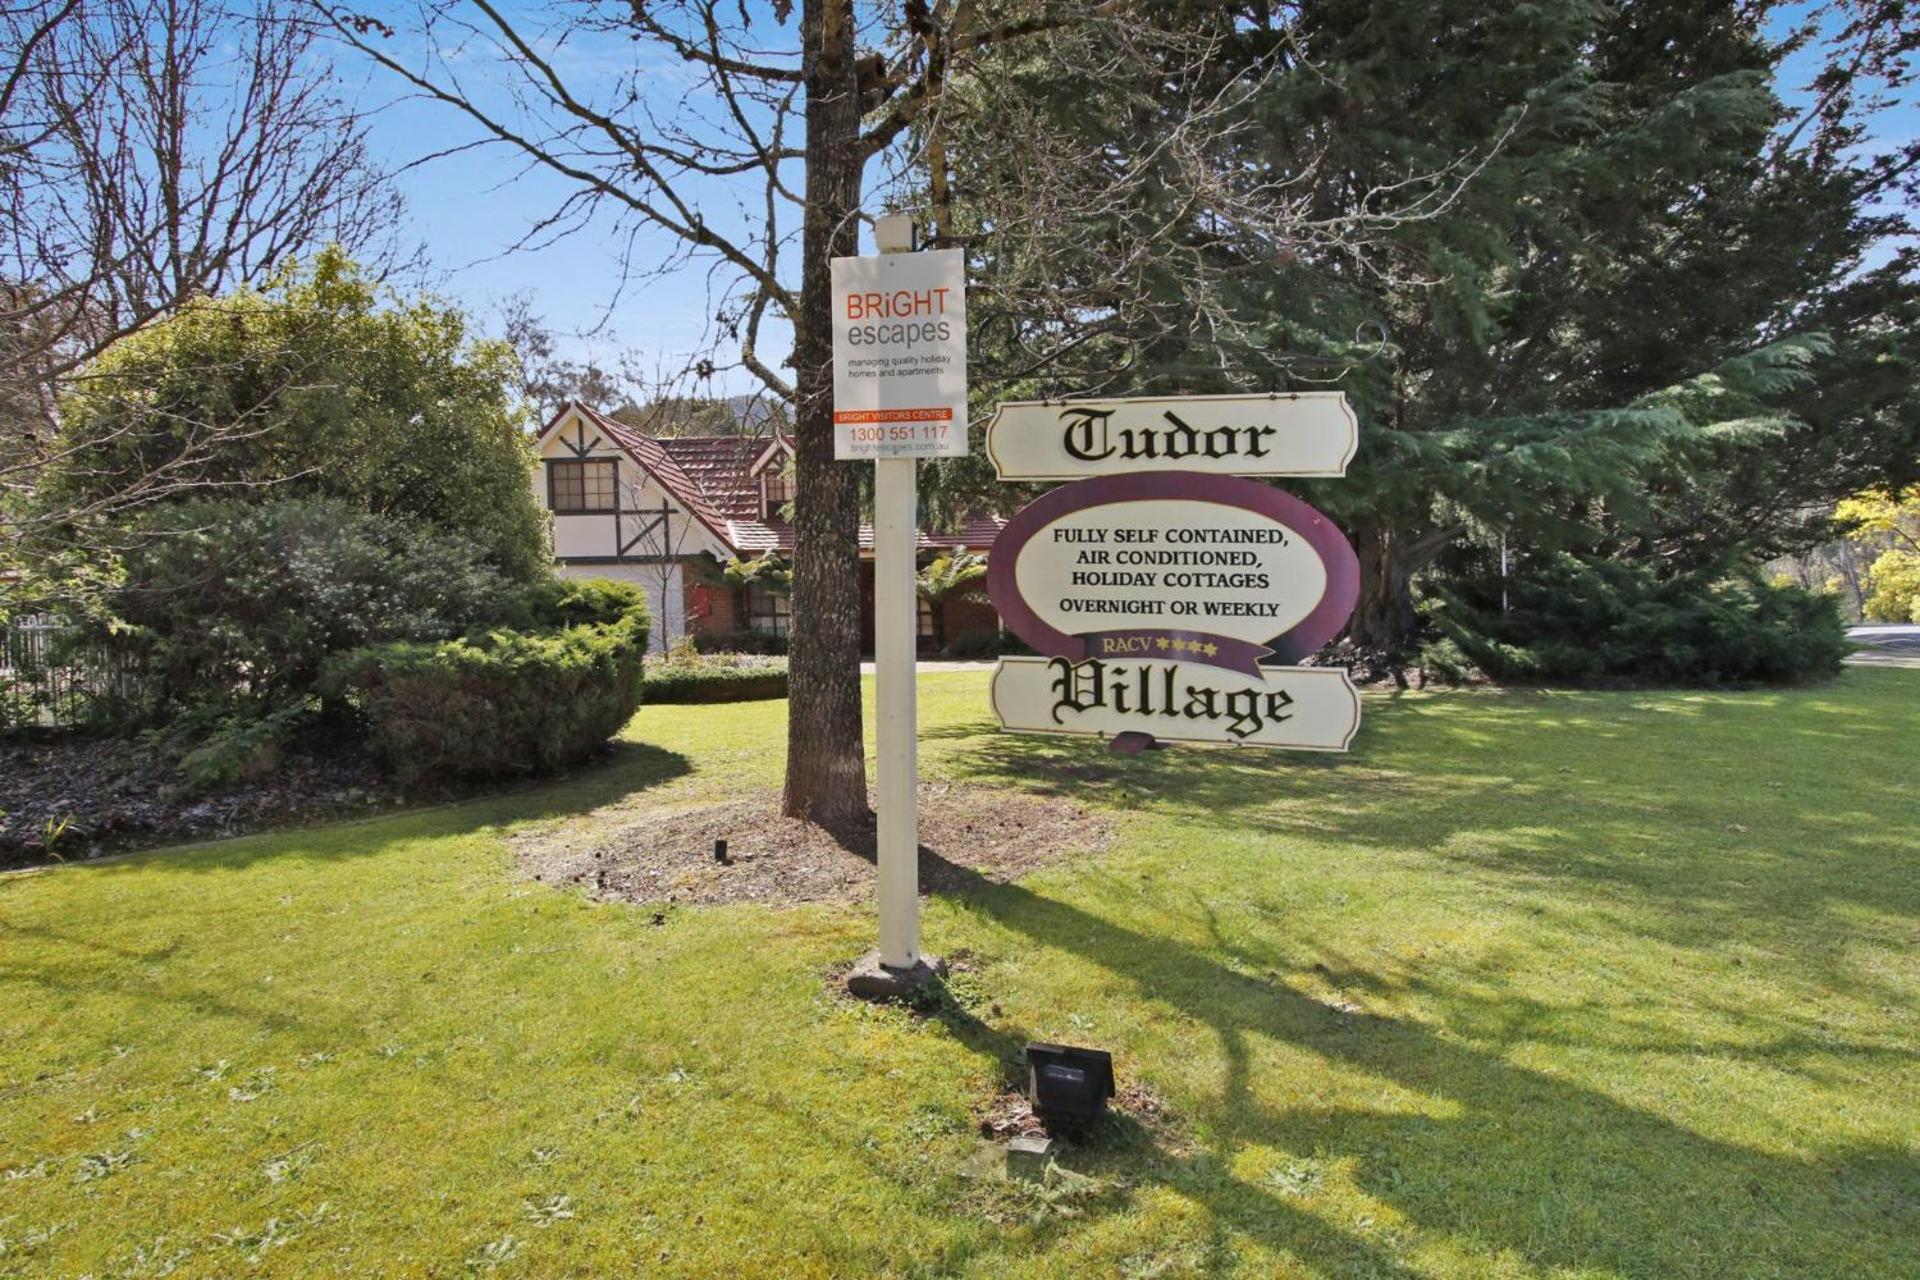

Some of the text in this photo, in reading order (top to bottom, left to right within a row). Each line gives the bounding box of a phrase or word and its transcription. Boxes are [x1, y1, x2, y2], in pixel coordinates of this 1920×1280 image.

[847, 288, 950, 320] BRiGHT
[848, 321, 951, 349] escapes
[848, 353, 951, 368] managing quality holiday
[848, 366, 944, 378] homes and apartments
[839, 409, 947, 422] BRIGHT VISITORS CENTRE
[850, 425, 948, 441] 1300 551 117
[1059, 407, 1277, 461] Tudor
[1053, 529, 1289, 547] FULLY SELF CONTAINED,
[1077, 550, 1263, 568] AIR CONDITIONED,
[1072, 571, 1270, 588] HOLIDAY COTTAGES
[1060, 598, 1280, 617] OVERNIGHT OR WEEKLY
[1102, 637, 1152, 653] RACV
[1048, 657, 1295, 738] Village
